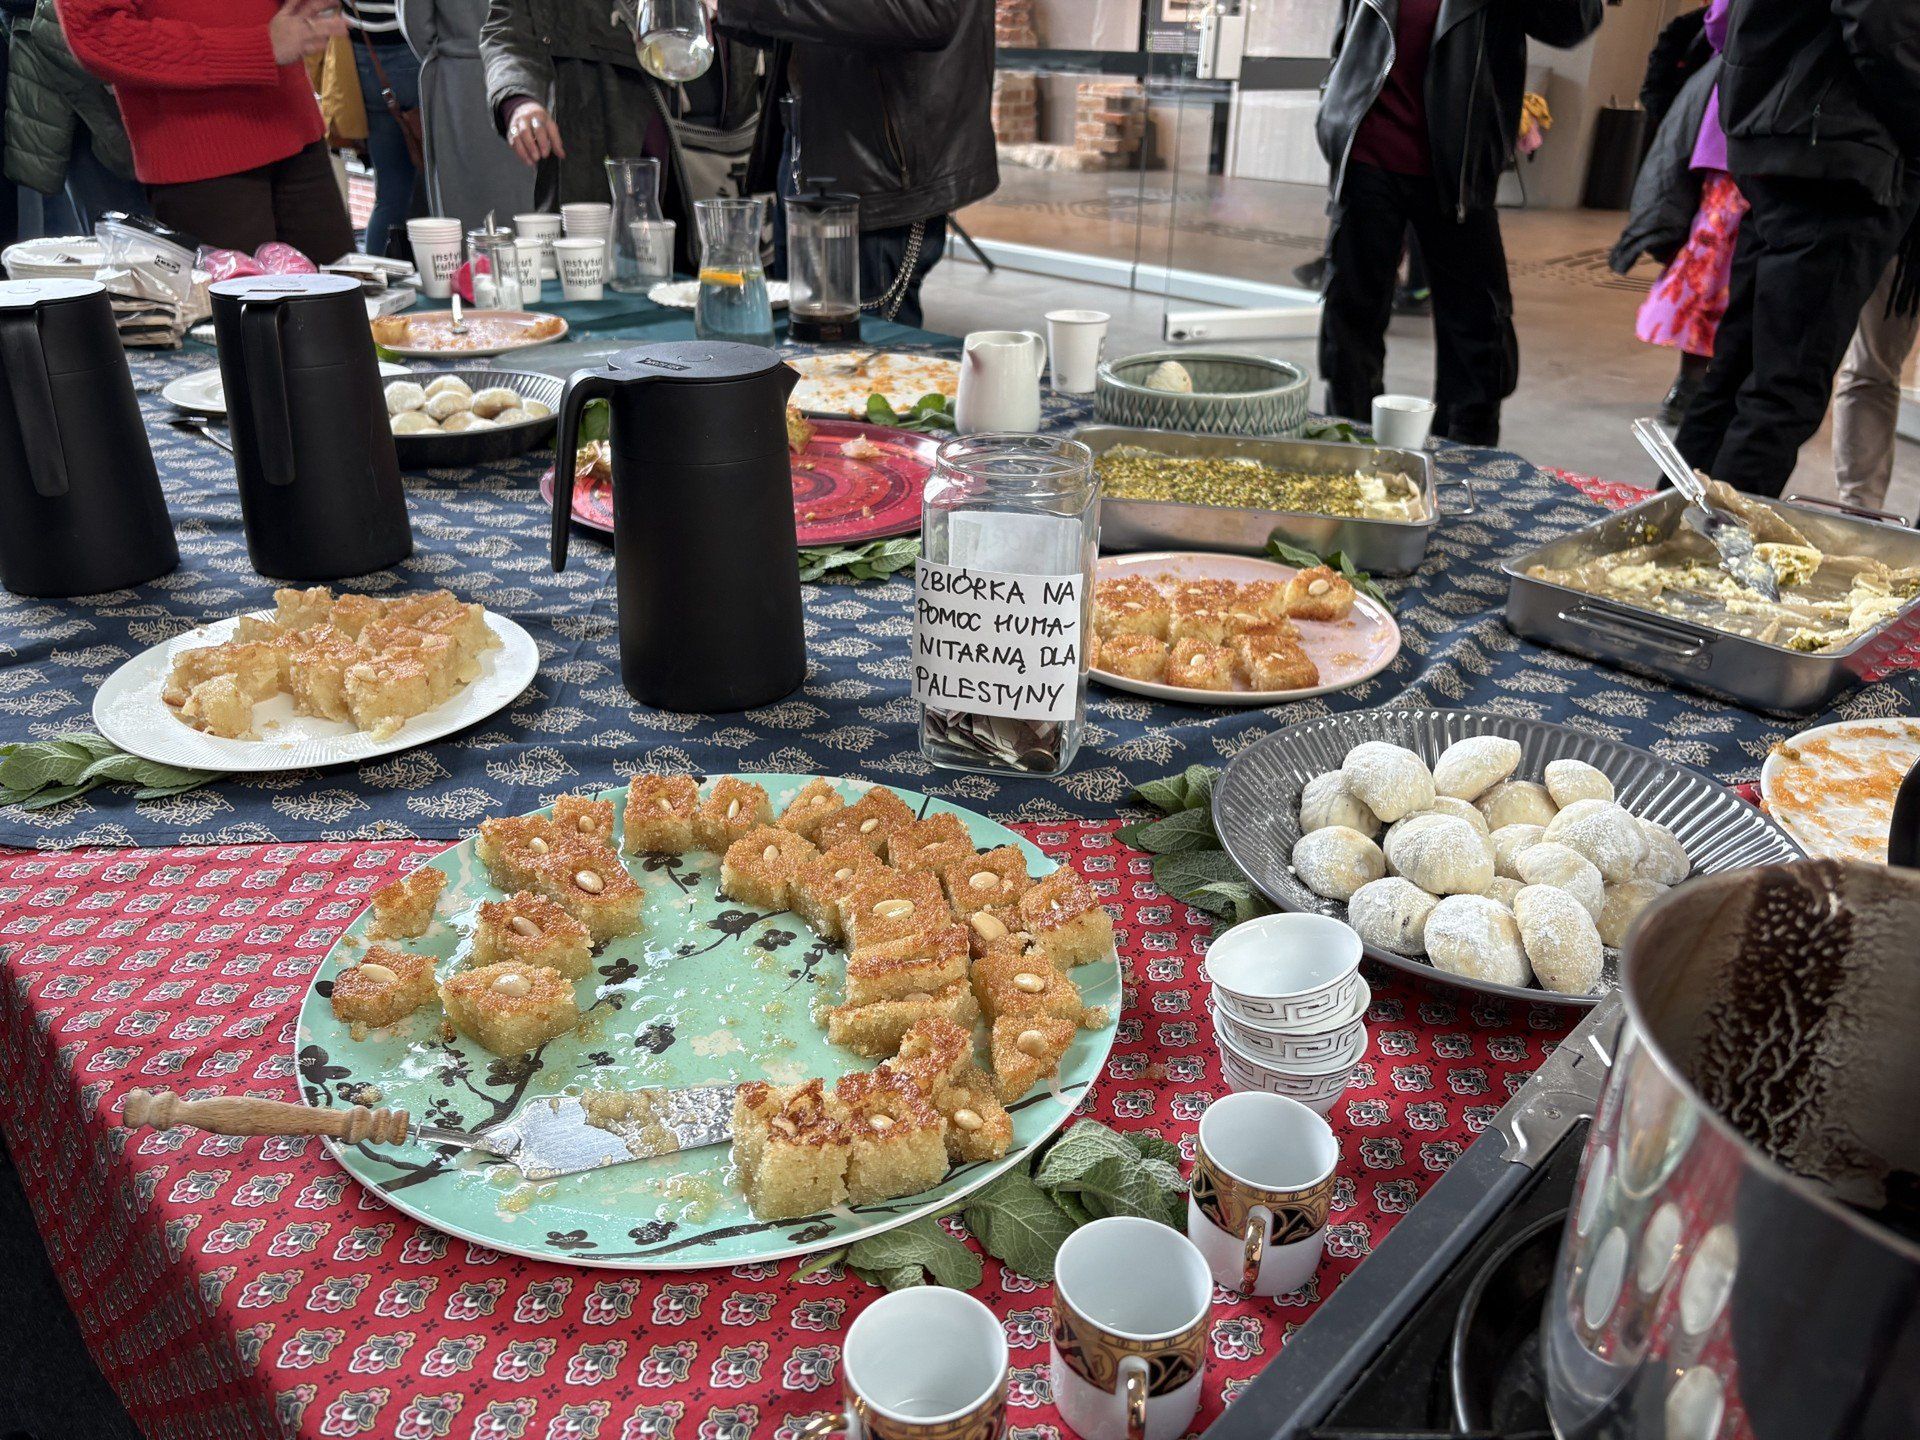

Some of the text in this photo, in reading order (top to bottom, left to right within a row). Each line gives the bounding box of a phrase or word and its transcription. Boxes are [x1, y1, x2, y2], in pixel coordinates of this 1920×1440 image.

[920, 567, 1075, 605] ZBIÓRKA NA
[917, 597, 1076, 638] POMOC HUMA-
[919, 633, 1076, 674] NITARNĄ DLA
[916, 665, 1065, 712] PALESTYNY
